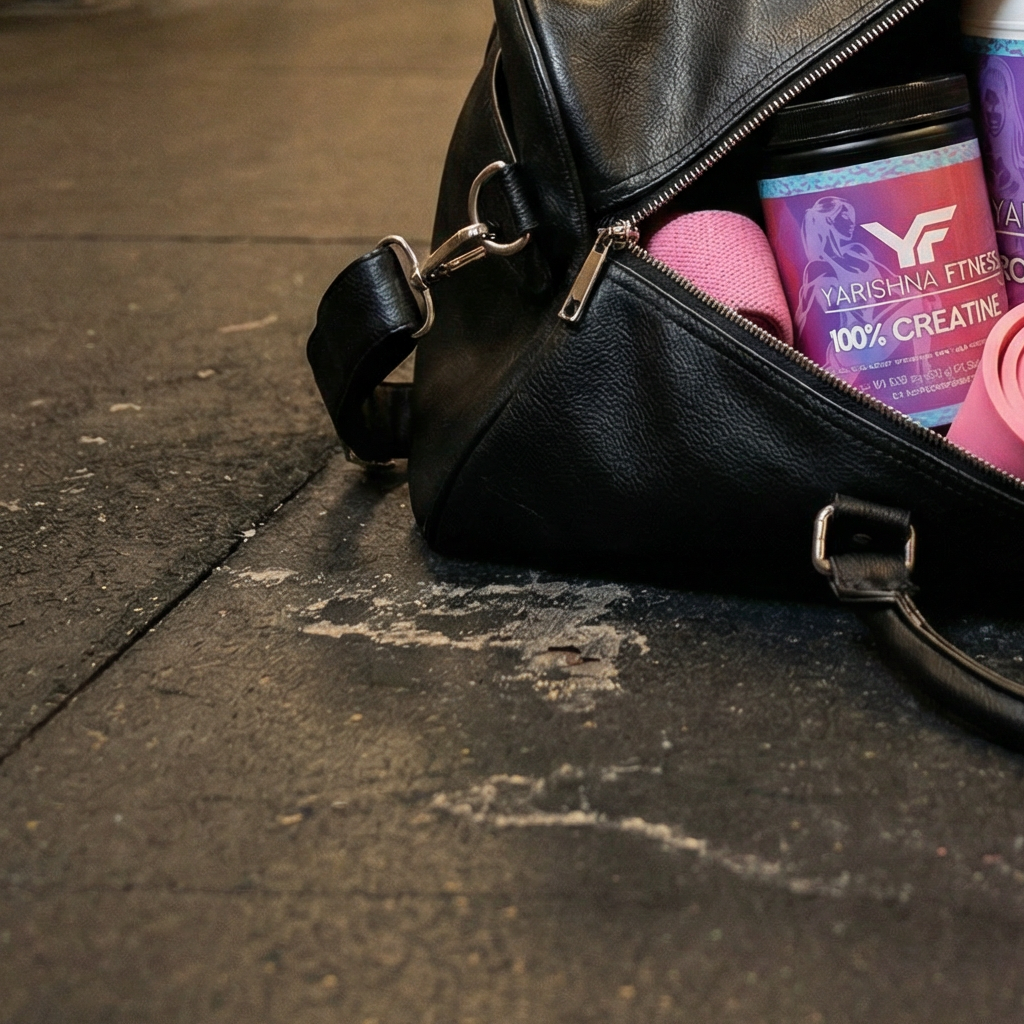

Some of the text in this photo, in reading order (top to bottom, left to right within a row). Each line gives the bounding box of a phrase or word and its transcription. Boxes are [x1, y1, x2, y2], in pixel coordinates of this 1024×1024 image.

[860, 204, 958, 269] YF
[821, 268, 939, 307] YARISHNA
[829, 292, 1002, 354] 100% CREATINE
